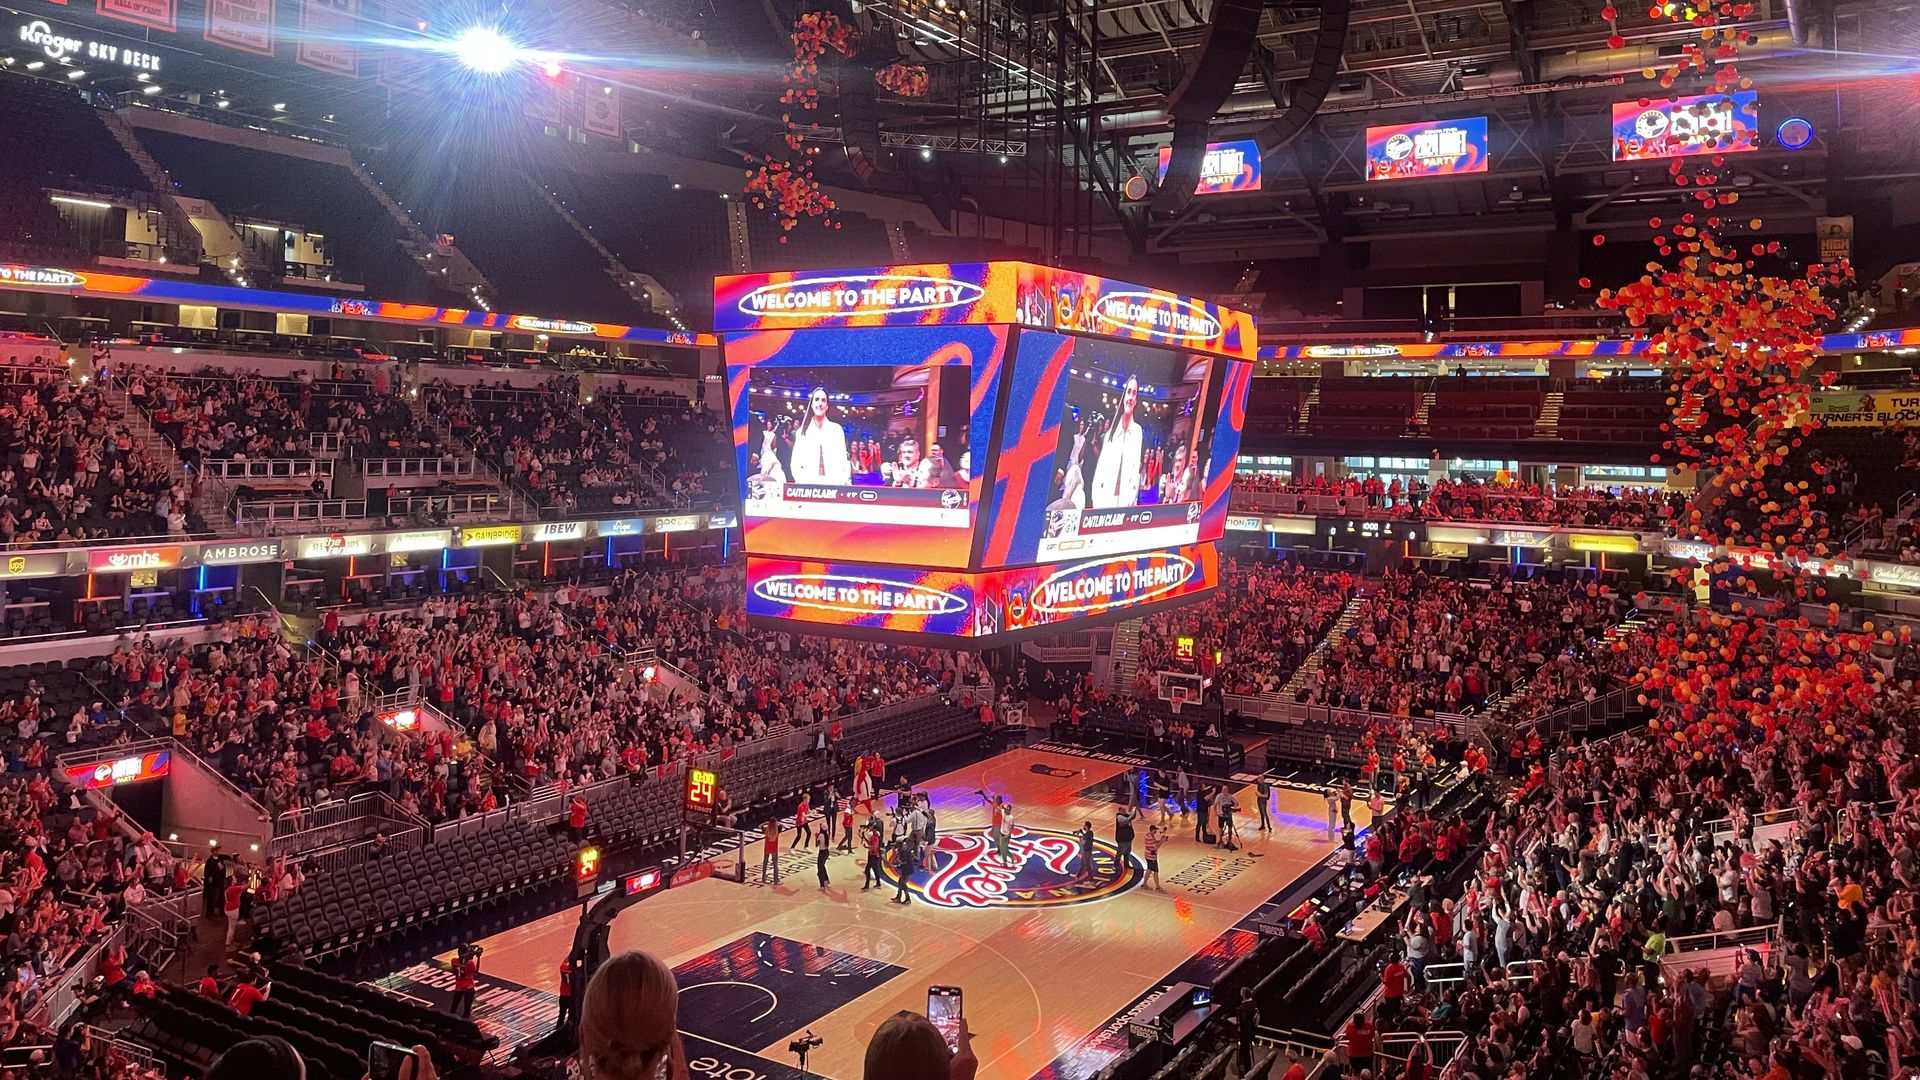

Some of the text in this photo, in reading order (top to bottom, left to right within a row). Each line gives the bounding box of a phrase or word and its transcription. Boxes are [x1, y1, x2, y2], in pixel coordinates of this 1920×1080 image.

[20, 21, 161, 70] Kroger SKY DECK
[1423, 156, 1458, 167] PARTY
[1207, 175, 1236, 184] PARTY
[14, 270, 36, 282] THE
[37, 272, 75, 285] PARTY
[751, 285, 964, 311] WELCOME TO THE PARTY
[519, 317, 593, 334] WELCOME TO THE PARTY
[1105, 300, 1217, 336] WELCOME TO THE PARTY
[1311, 346, 1395, 355] WELCOME TO THE PARTY
[1810, 413, 1873, 422] TURNER'S
[786, 487, 812, 498] CAITLIN
[812, 488, 838, 499] CLARK
[544, 523, 576, 534] IBEW
[656, 518, 676, 529] aes
[1082, 515, 1106, 529] CAITLIN
[1105, 513, 1126, 526] CLARK
[475, 530, 519, 540] GAINBRIDGE
[128, 550, 160, 566] mhs
[203, 545, 278, 560] AMBROSE
[11, 560, 24, 571] ups
[1045, 562, 1187, 605] WELCOME TO THE PARTY
[765, 581, 949, 611] WELCOME TO THE PARTY
[1177, 644, 1193, 657] 24
[1028, 743, 1151, 766] INDIANA PACERS
[693, 770, 715, 786] 10:00
[690, 781, 712, 804] 24
